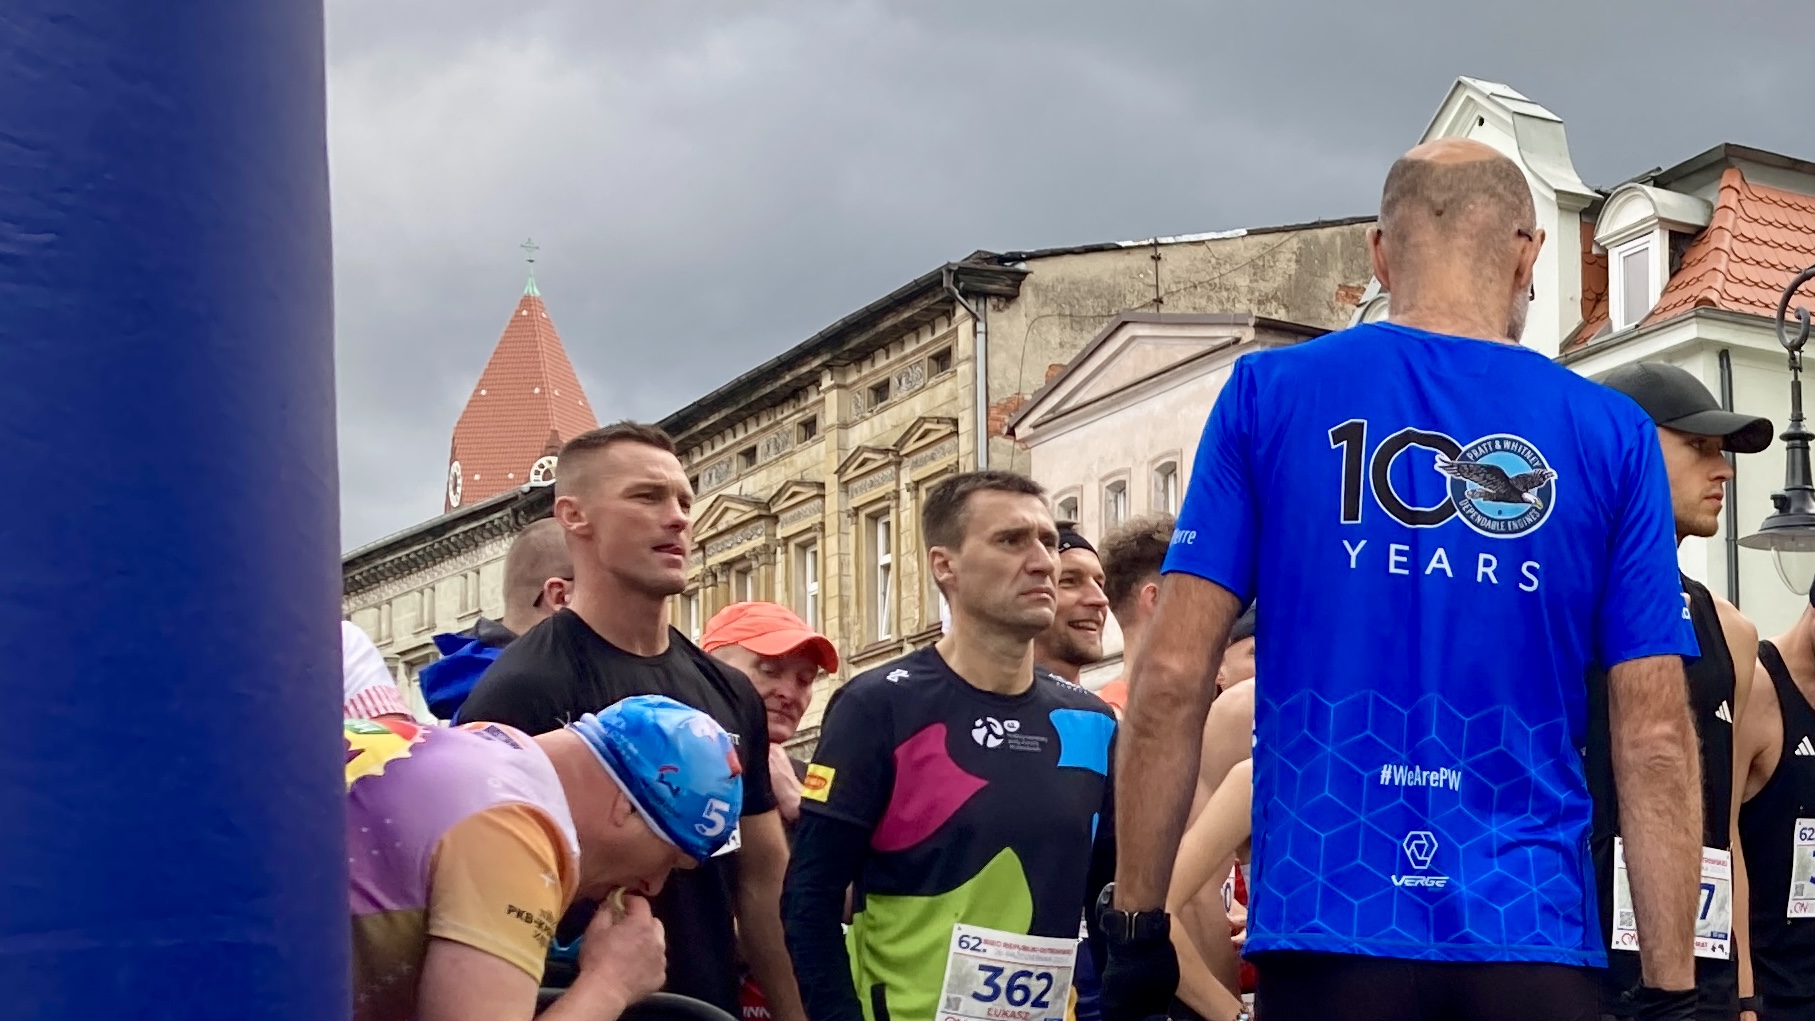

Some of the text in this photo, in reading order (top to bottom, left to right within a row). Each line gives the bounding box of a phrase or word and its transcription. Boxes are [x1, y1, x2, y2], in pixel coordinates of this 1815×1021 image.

[1466, 439, 1542, 468] PRATT & WHITNEY
[1459, 498, 1541, 531] DEPENDABLE ENGINES
[1342, 539, 1541, 592] YEARS
[1380, 764, 1461, 791] #WeArePW
[695, 798, 731, 837] 5
[1391, 874, 1449, 887] VERGE
[958, 934, 987, 953] 62.
[971, 964, 1054, 1008] 362
